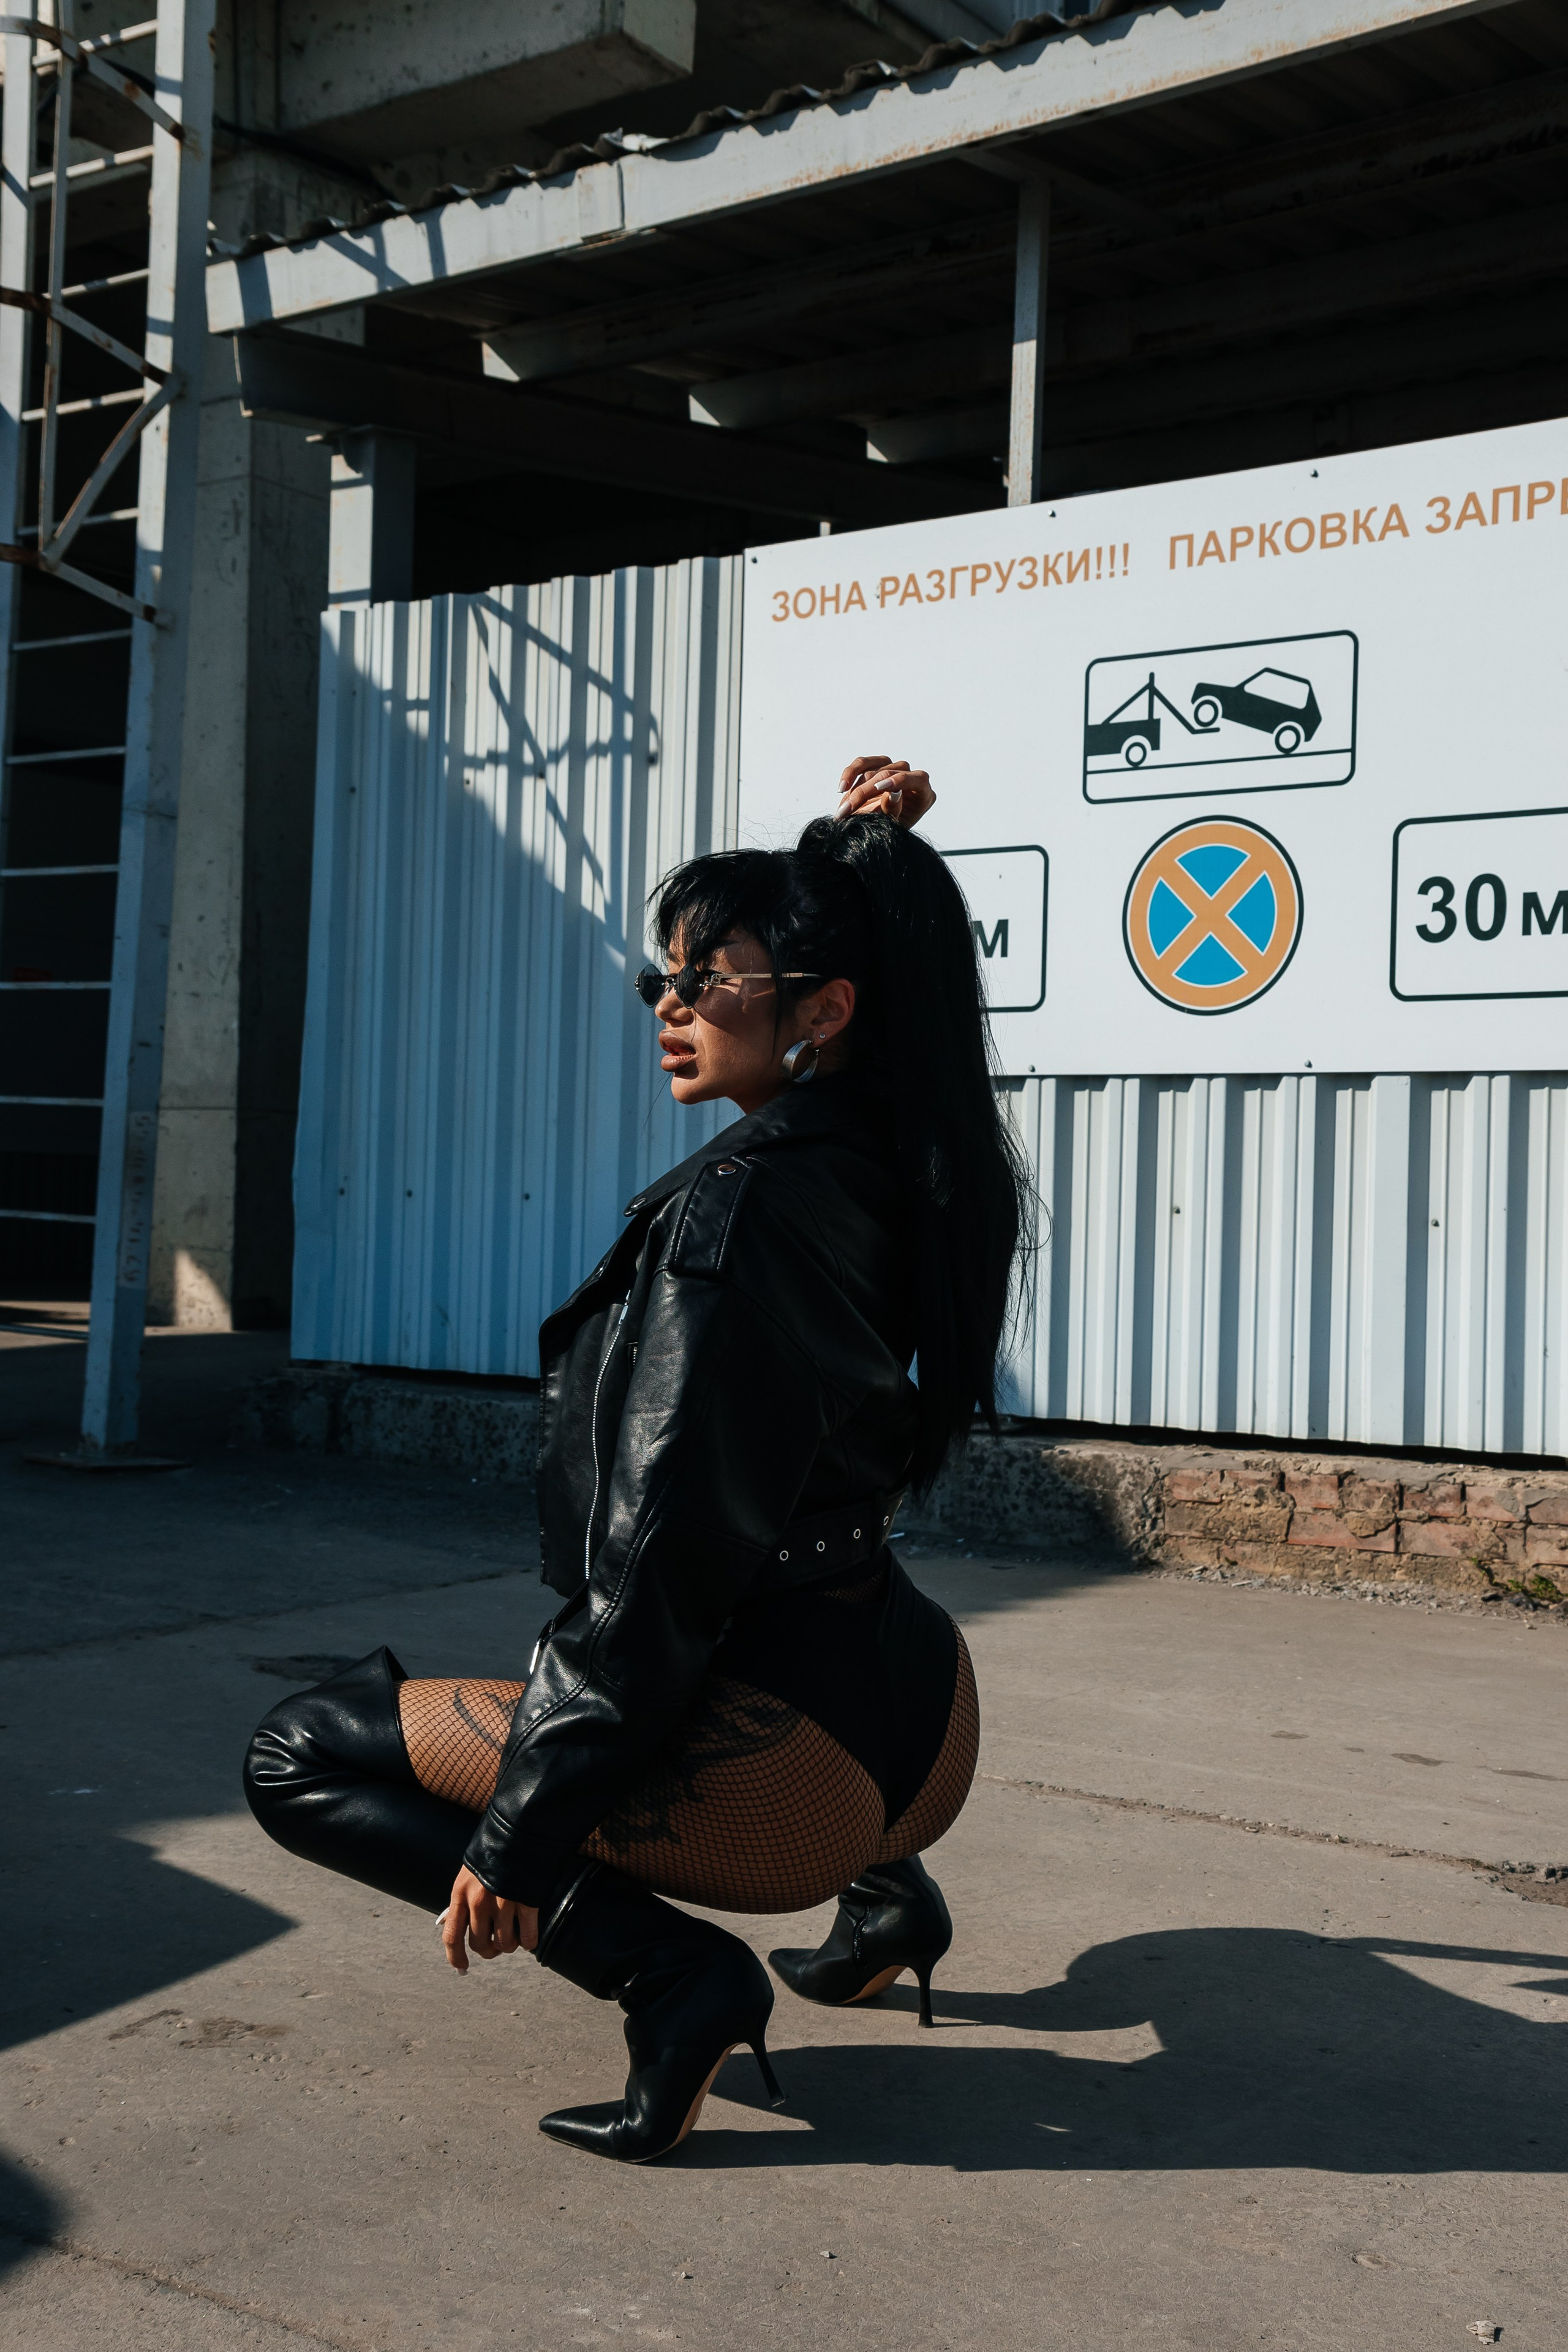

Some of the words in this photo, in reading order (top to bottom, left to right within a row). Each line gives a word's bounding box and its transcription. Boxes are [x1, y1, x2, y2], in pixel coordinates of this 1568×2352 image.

[772, 581, 867, 622] ЗОНА
[879, 543, 1129, 608] РАЗГРУЗКИ!!!
[1169, 503, 1409, 570] ПАРКОВКА
[1415, 873, 1507, 943] 30
